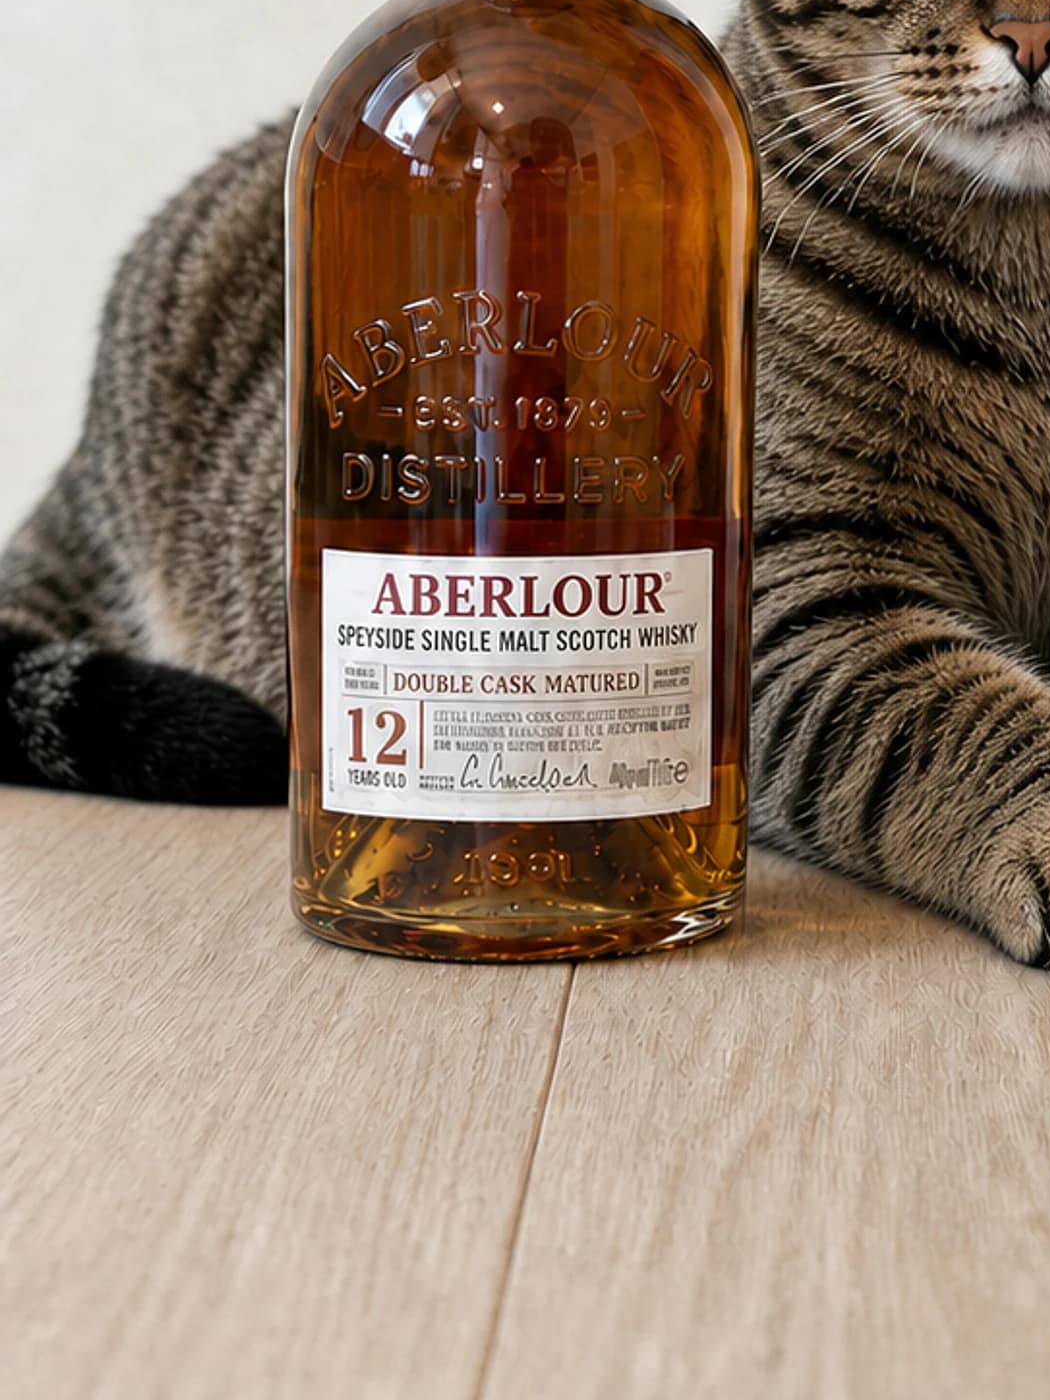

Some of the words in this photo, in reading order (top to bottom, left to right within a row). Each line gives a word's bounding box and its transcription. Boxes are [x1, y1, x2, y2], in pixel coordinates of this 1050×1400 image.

[319, 288, 714, 429] ABERLOUR
[342, 451, 687, 505] DISTILLERY
[371, 572, 666, 618] ABERLOUR
[338, 624, 415, 651] SPEYSIDE
[421, 629, 491, 652] SINGLE
[499, 630, 550, 652] MALT
[556, 629, 631, 651] SCOTCH
[638, 622, 698, 648] WHISKY
[393, 672, 474, 694] DOUBLE
[480, 674, 537, 695] CASK
[545, 671, 640, 694] MATURED
[347, 707, 407, 766] 12
[347, 767, 381, 788] YEARS
[384, 769, 407, 789] OLD
